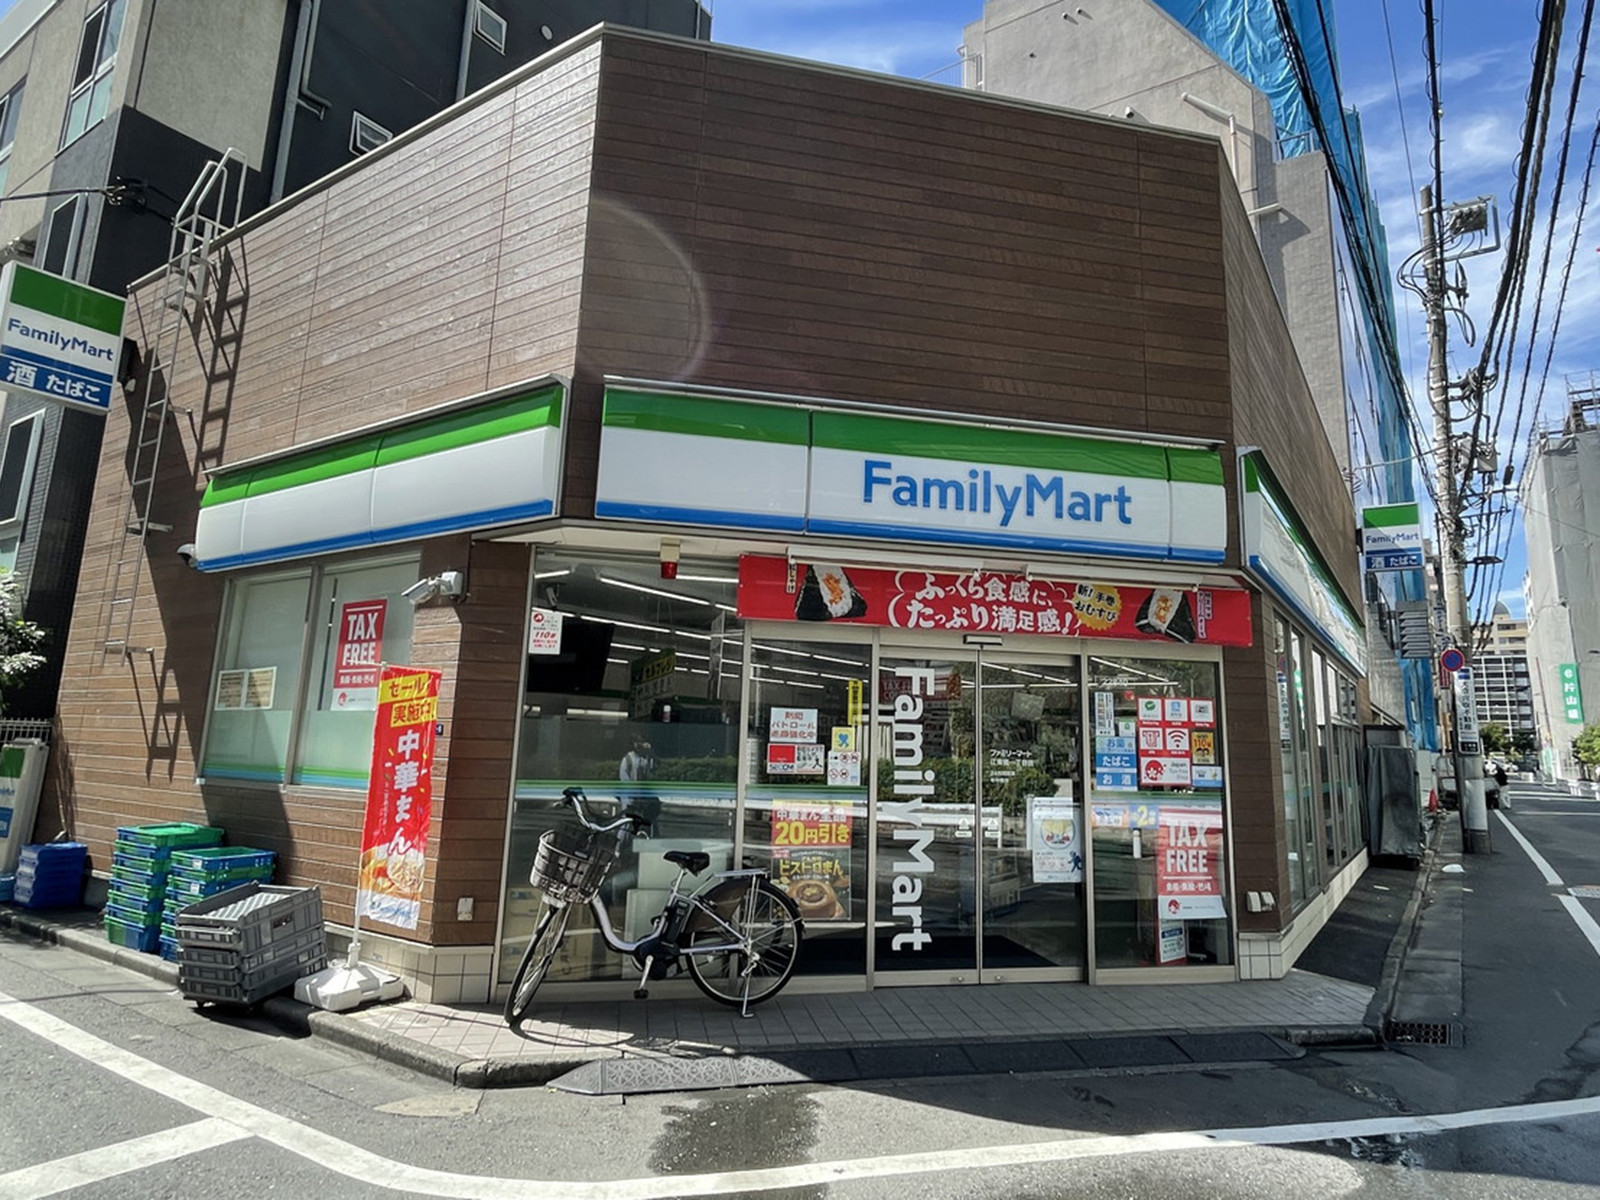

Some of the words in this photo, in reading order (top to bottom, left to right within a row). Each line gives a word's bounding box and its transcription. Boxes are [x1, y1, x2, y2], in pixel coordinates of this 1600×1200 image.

[8, 318, 114, 361] FamilyMart
[6, 361, 38, 388] 酒
[46, 374, 101, 402] たばこ
[863, 460, 1132, 527] FamilyMart
[1366, 533, 1419, 543] FamilyMart
[1371, 556, 1385, 568] 酒
[1390, 555, 1418, 567] たばこ
[915, 573, 1052, 606] ふっくら食感に、
[906, 600, 1073, 634] たっぷり満足感!
[1074, 600, 1116, 621] おむすび
[348, 612, 378, 641] TAX
[342, 642, 376, 666] FREE
[390, 677, 426, 698] セール
[771, 721, 816, 729] パトロール
[1102, 756, 1131, 767] たばこ
[387, 729, 420, 857] 中華まん
[776, 808, 848, 823] 中華まん全品
[880, 667, 935, 951] FamilyMart
[775, 821, 850, 845] 20円引き
[1167, 819, 1209, 848] TAX
[1165, 850, 1209, 873] FREE
